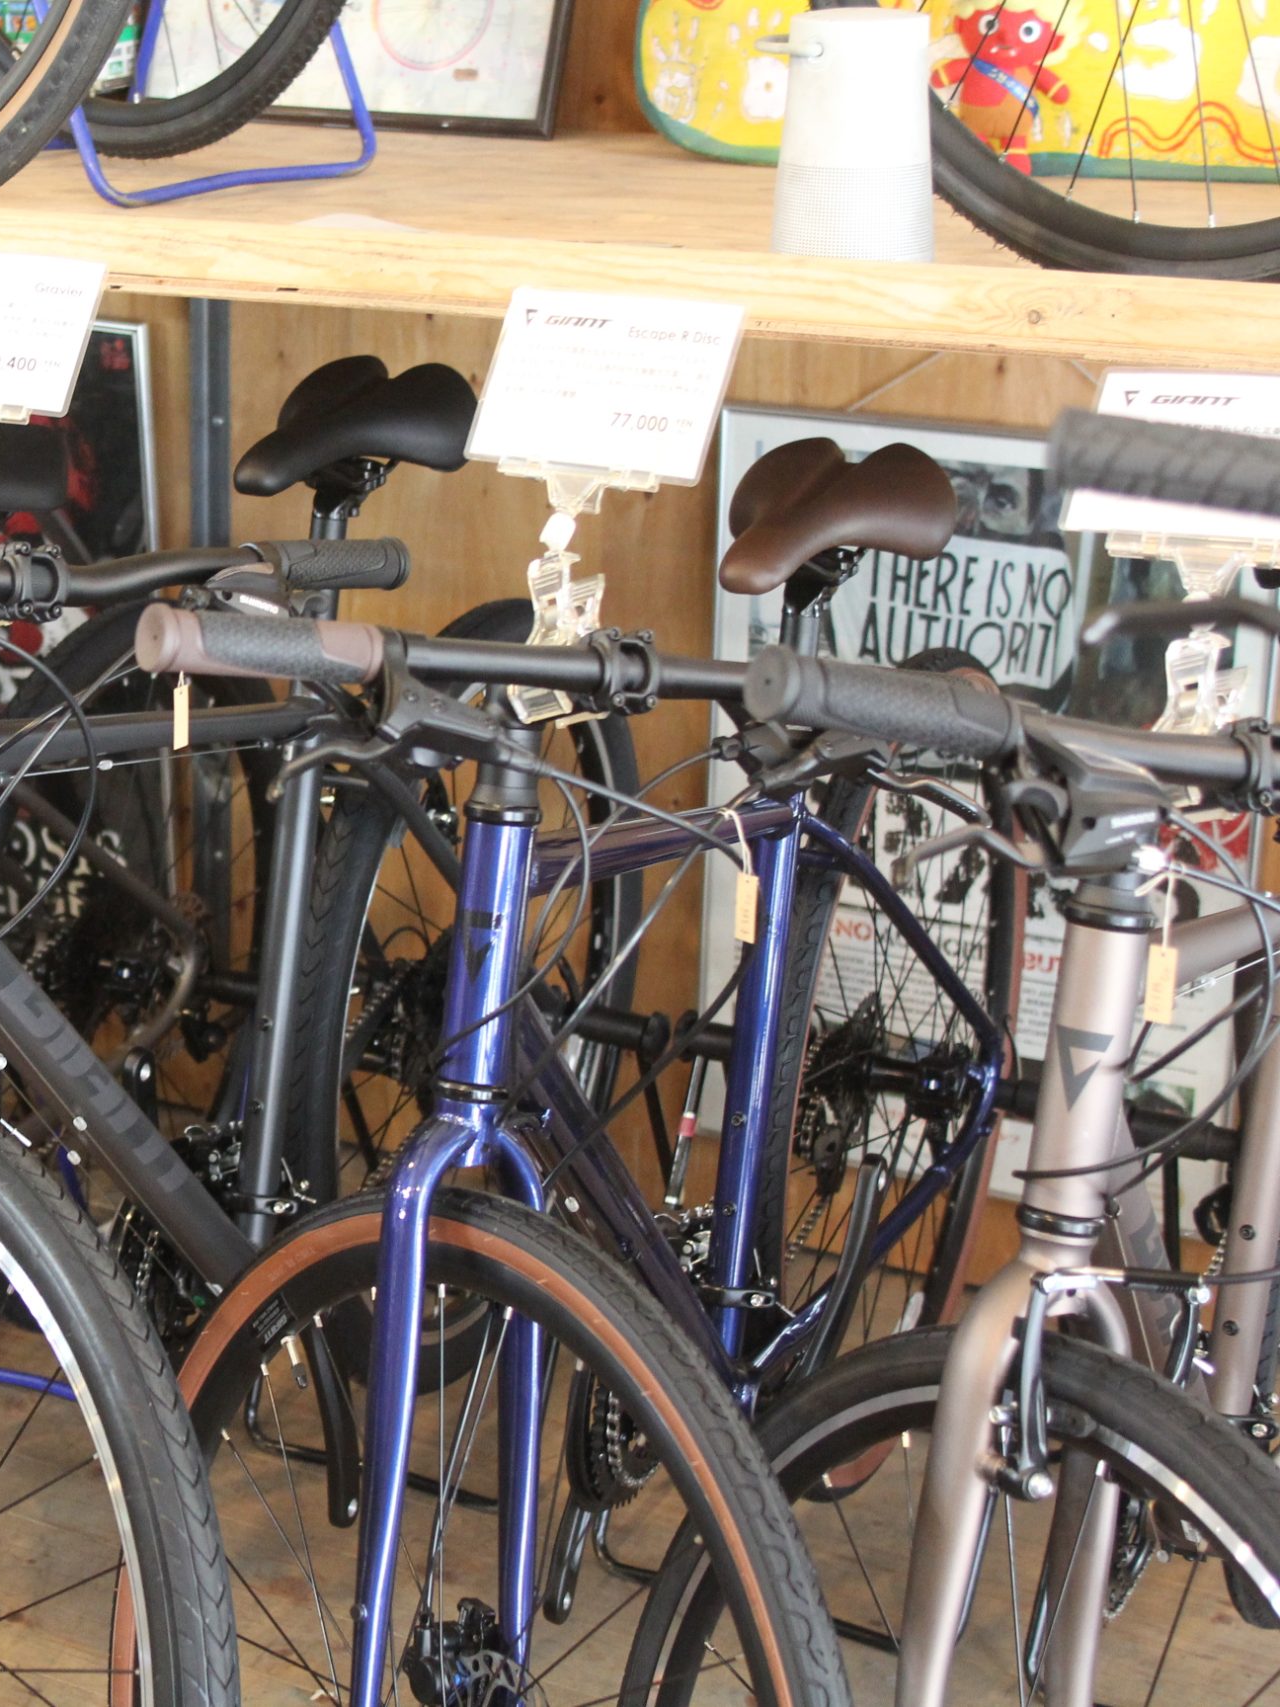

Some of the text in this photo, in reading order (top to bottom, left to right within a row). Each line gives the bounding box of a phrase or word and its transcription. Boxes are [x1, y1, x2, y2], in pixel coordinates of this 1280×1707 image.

[34, 281, 84, 298] Gravier
[543, 314, 614, 330] GIANT
[627, 325, 721, 346] Escape R Disc
[1150, 394, 1241, 407] GIANT
[985, 559, 1015, 618] IS
[1018, 562, 1072, 620] NO
